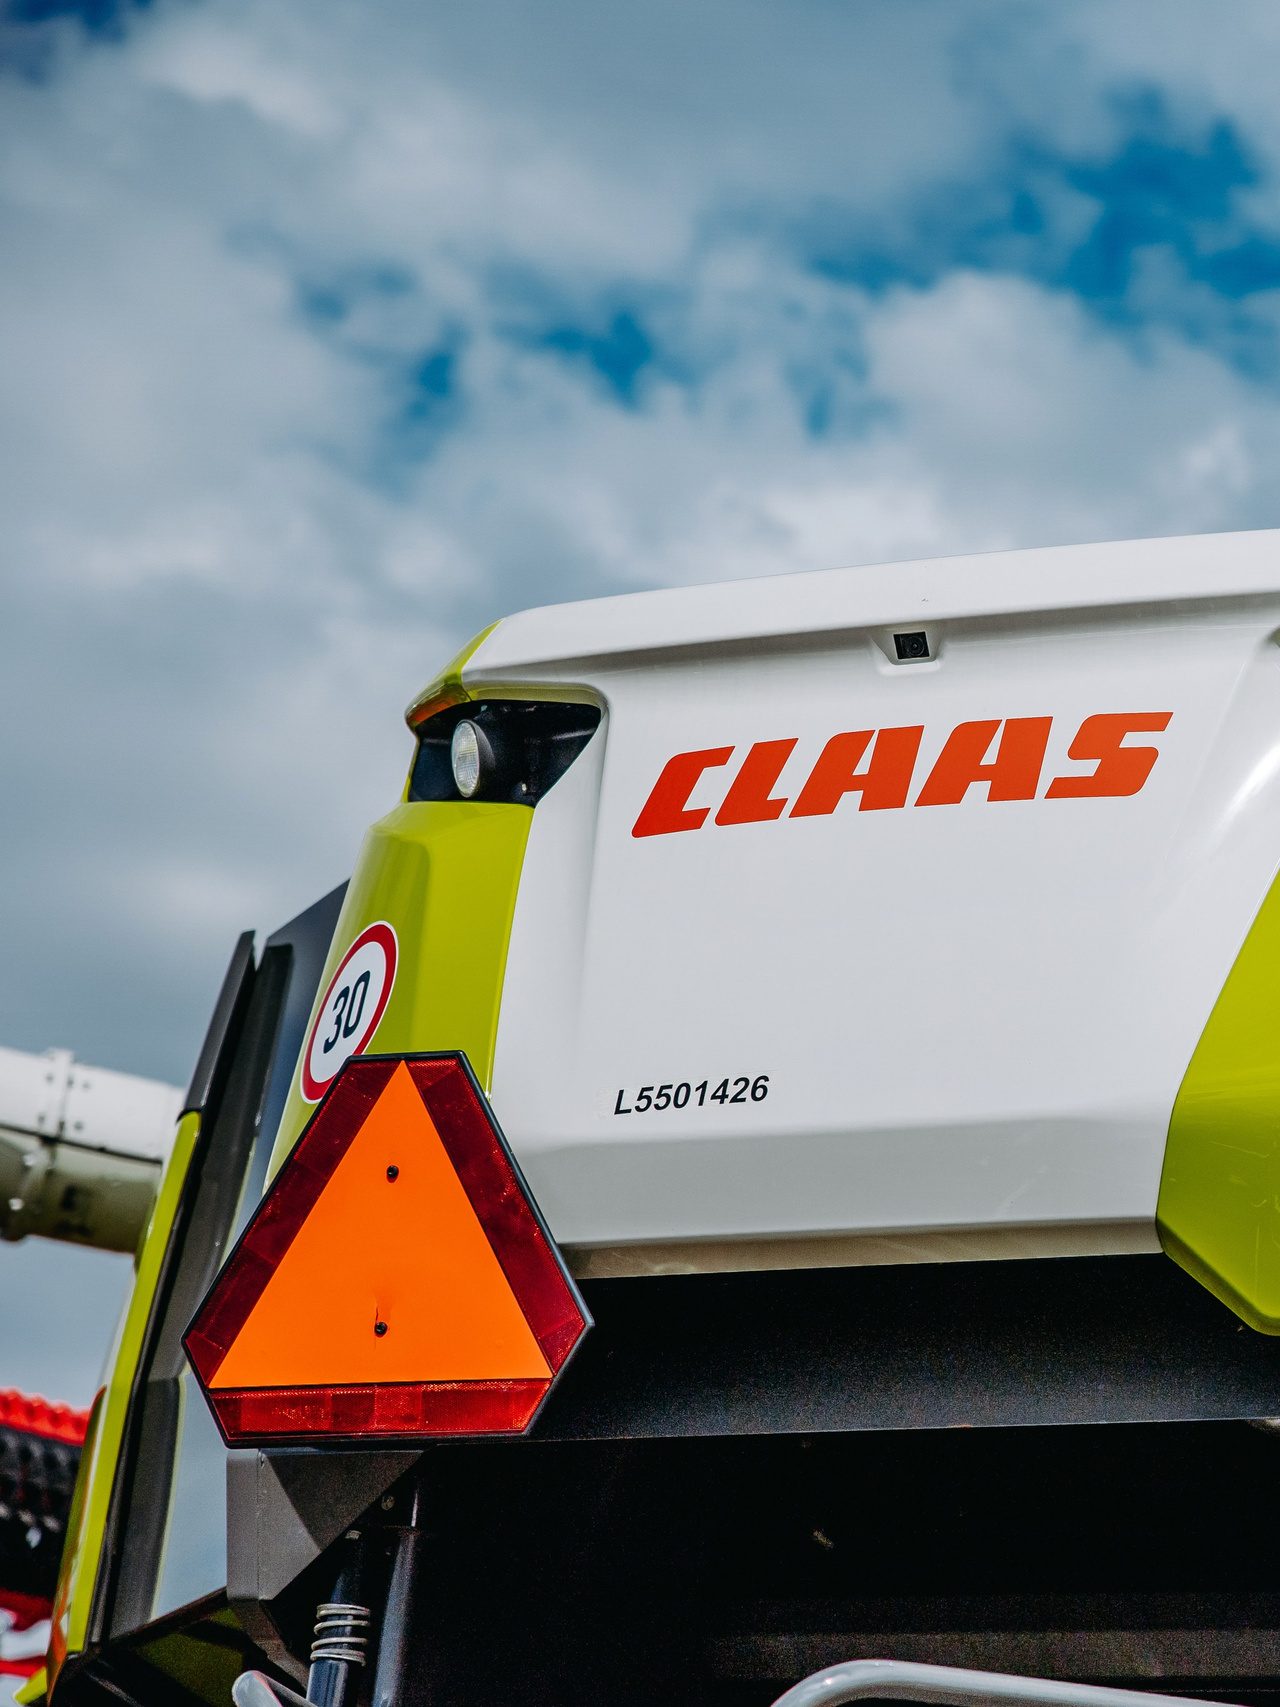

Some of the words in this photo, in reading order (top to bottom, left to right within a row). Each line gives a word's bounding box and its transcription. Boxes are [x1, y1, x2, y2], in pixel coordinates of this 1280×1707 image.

[632, 712, 1173, 838] CLAAS
[323, 970, 371, 1054] 30
[614, 1075, 770, 1115] L5501426
